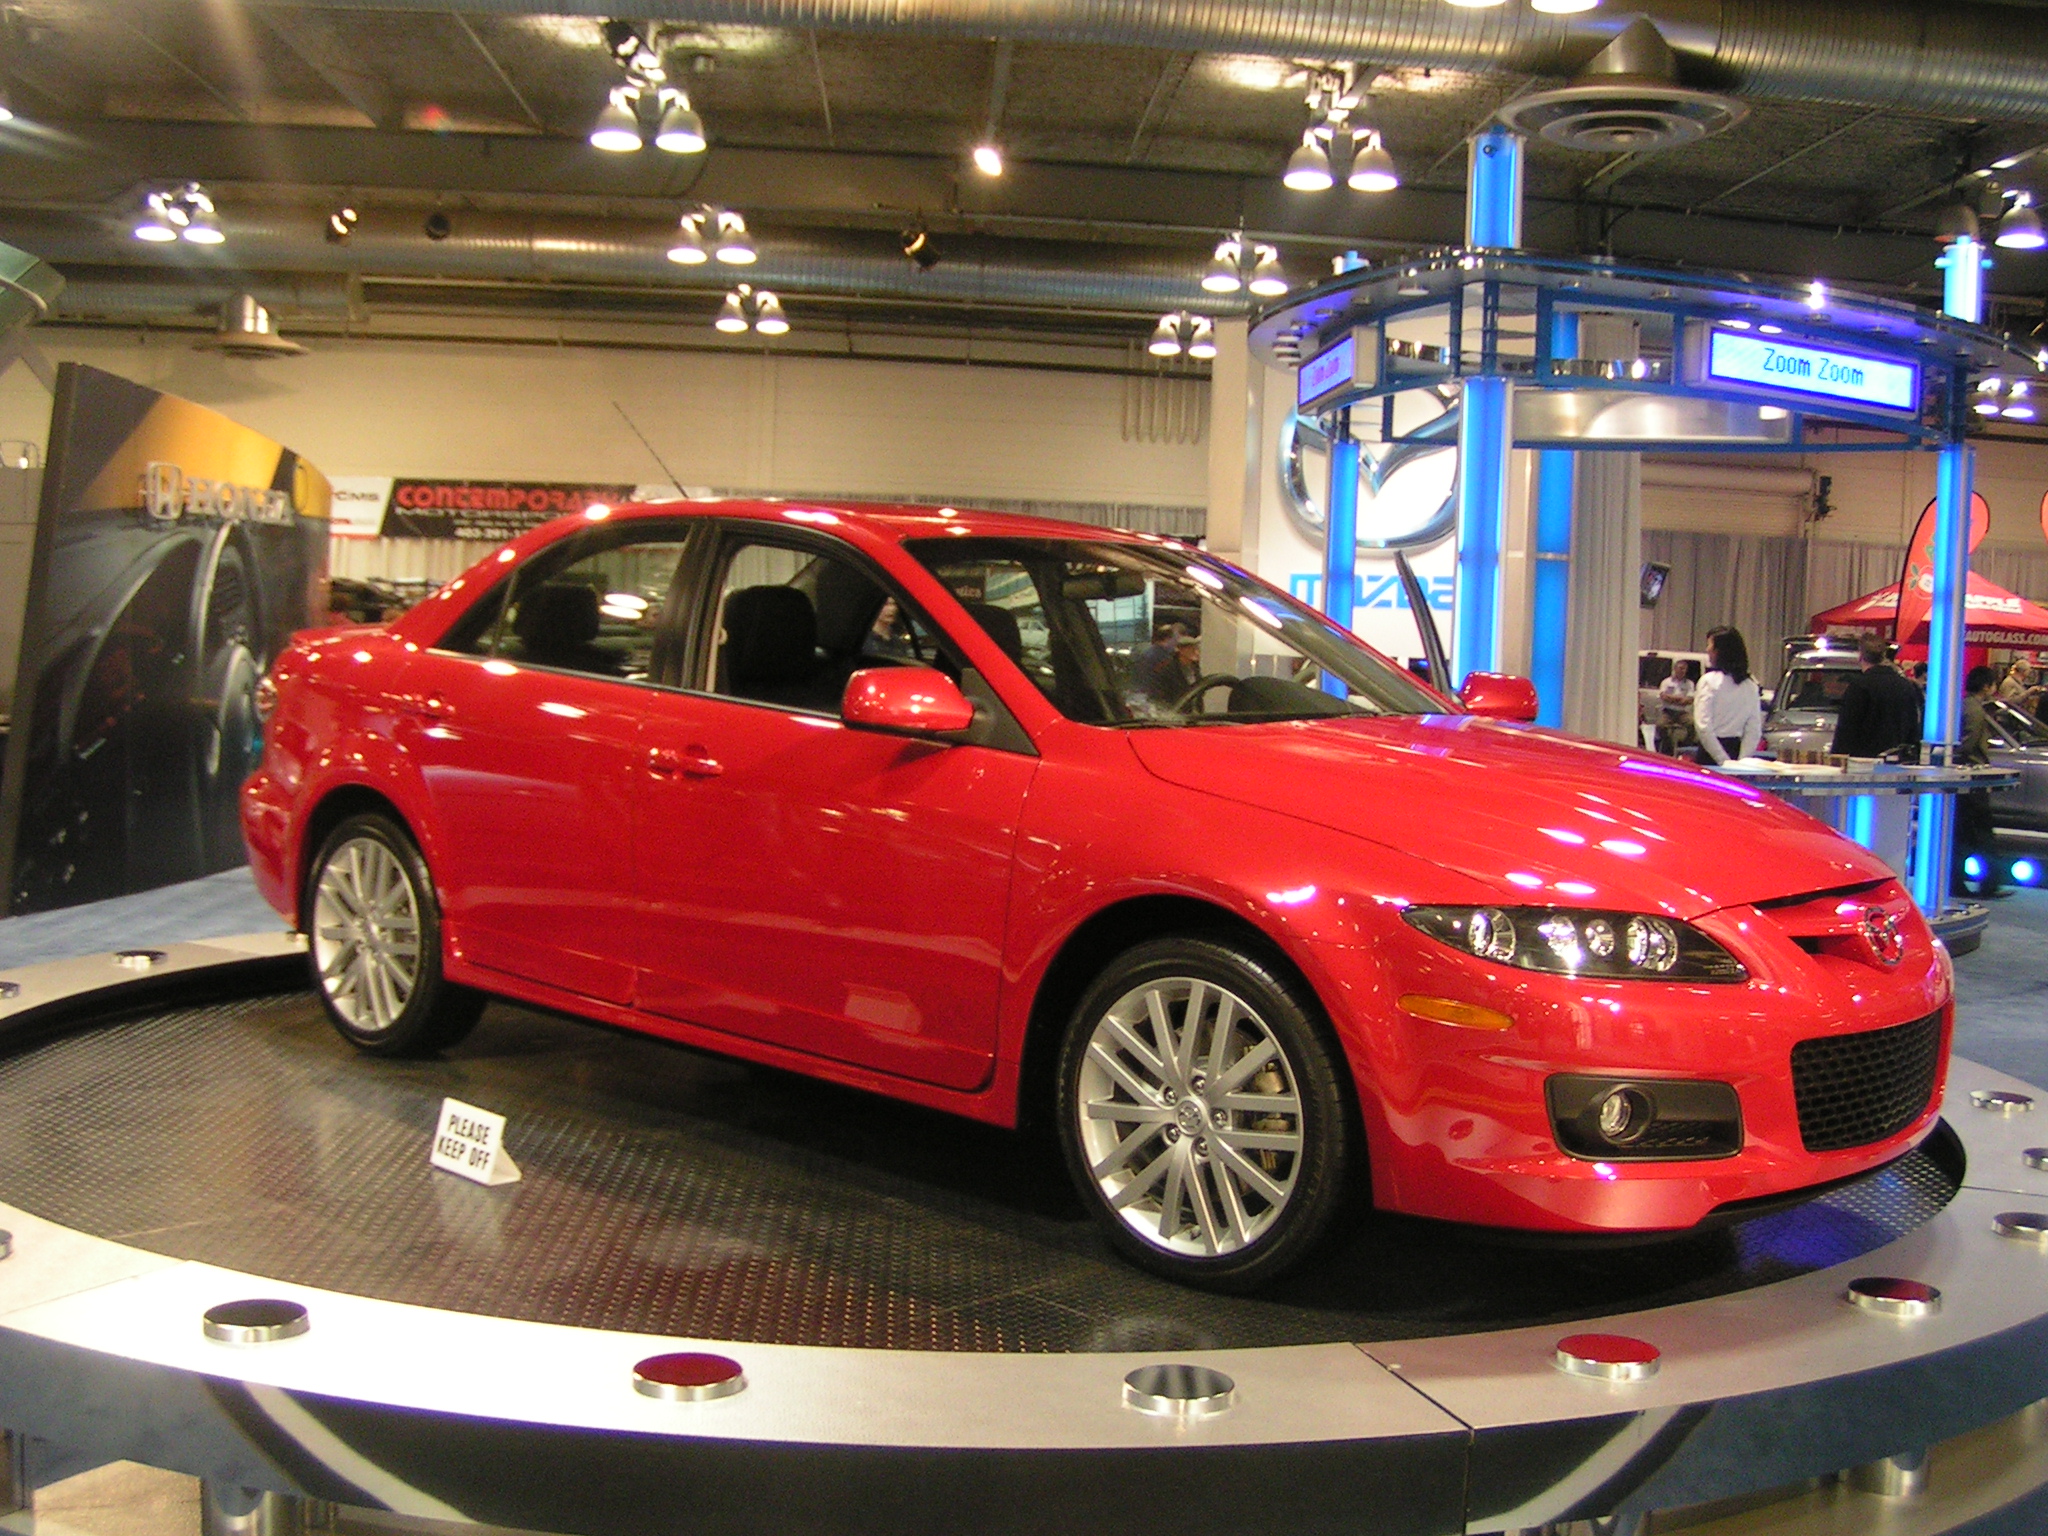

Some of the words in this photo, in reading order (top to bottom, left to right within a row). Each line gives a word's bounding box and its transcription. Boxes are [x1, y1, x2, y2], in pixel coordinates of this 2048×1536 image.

[1763, 348, 1811, 377] Zoom
[1818, 357, 1864, 387] Zoom
[448, 1113, 491, 1146] PLEASE
[437, 1135, 467, 1161] KEEP
[469, 1147, 491, 1171] OFF
